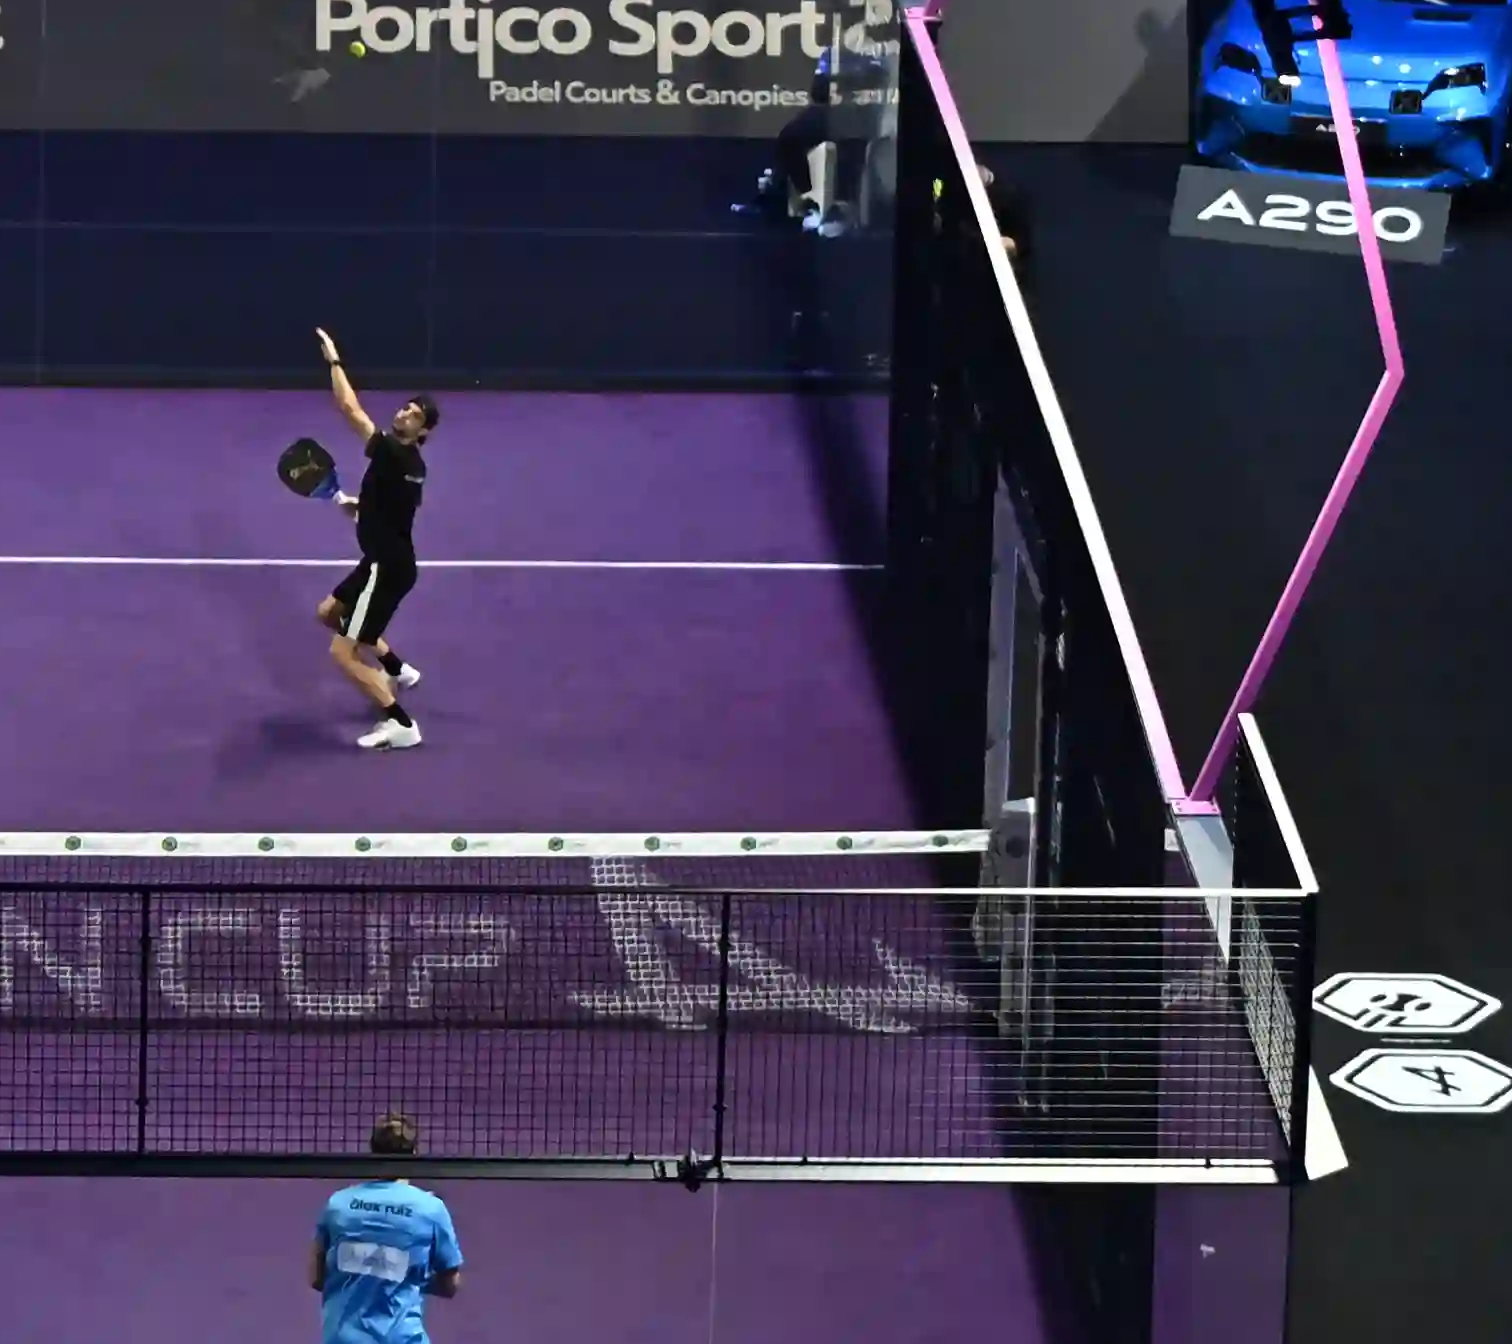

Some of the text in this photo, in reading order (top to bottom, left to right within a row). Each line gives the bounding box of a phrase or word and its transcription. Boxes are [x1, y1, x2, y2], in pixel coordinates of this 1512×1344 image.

[489, 79, 810, 110] Padel Courts & Canopies
[1197, 189, 1424, 243] A290
